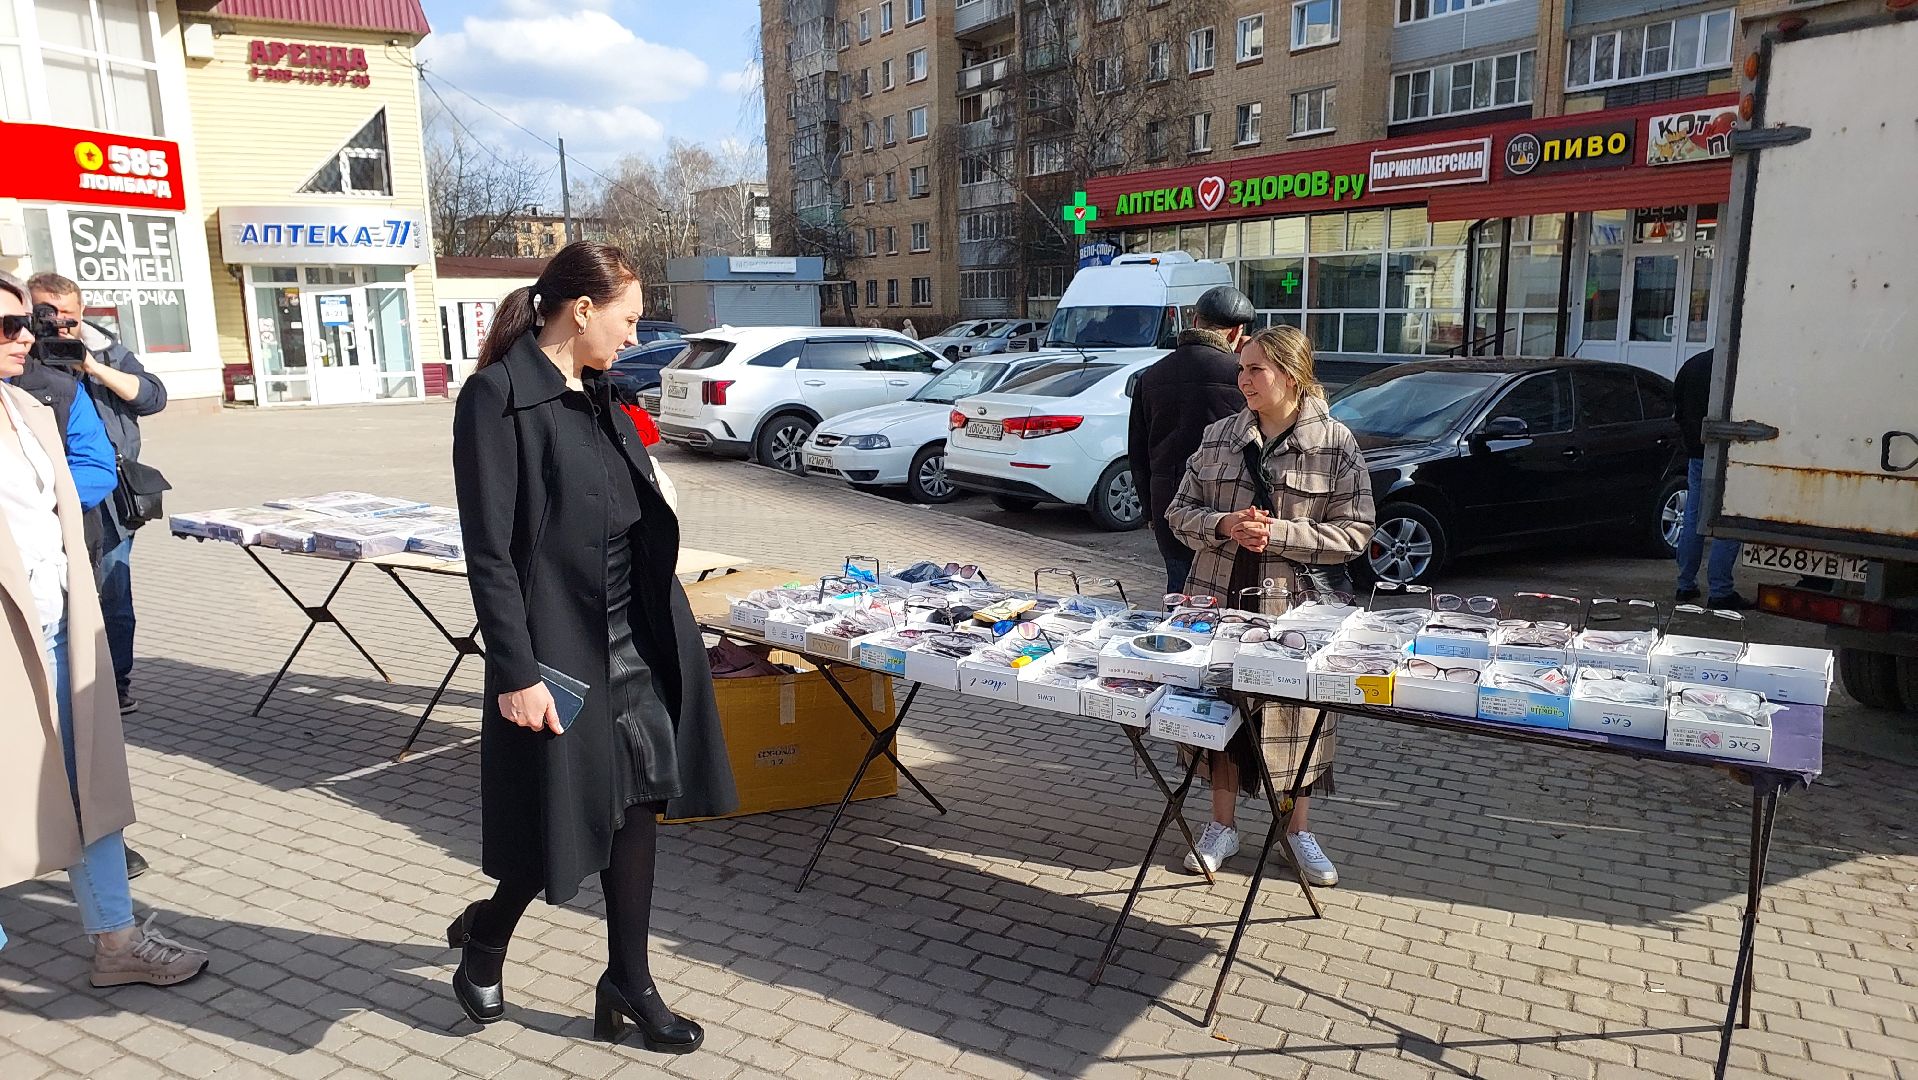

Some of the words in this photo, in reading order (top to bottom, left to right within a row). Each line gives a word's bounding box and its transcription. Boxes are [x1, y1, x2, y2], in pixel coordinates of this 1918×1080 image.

[248, 40, 368, 71] АРЕНДА
[1657, 114, 1711, 139] КОТ
[1511, 141, 1534, 153] BEER
[1543, 132, 1627, 163] ПИВО
[108, 145, 169, 178] 585
[1373, 150, 1484, 180] ПАРИКМАХЕРСКАЯ
[79, 173, 172, 199] ЛОМБАРД
[1115, 186, 1195, 216] АПТЕКА
[1228, 170, 1367, 209] ЗДОРОВ.ру
[72, 217, 171, 256] SALE
[240, 223, 373, 246] АПТЕКА
[79, 256, 175, 283] ОБМЕН
[82, 289, 178, 307] РАССРОЧКА
[1749, 546, 1839, 575] А268УВ
[1277, 676, 1301, 686] LEWIS
[1037, 693, 1056, 703] LEWIS
[1192, 731, 1216, 741] LEWIS
